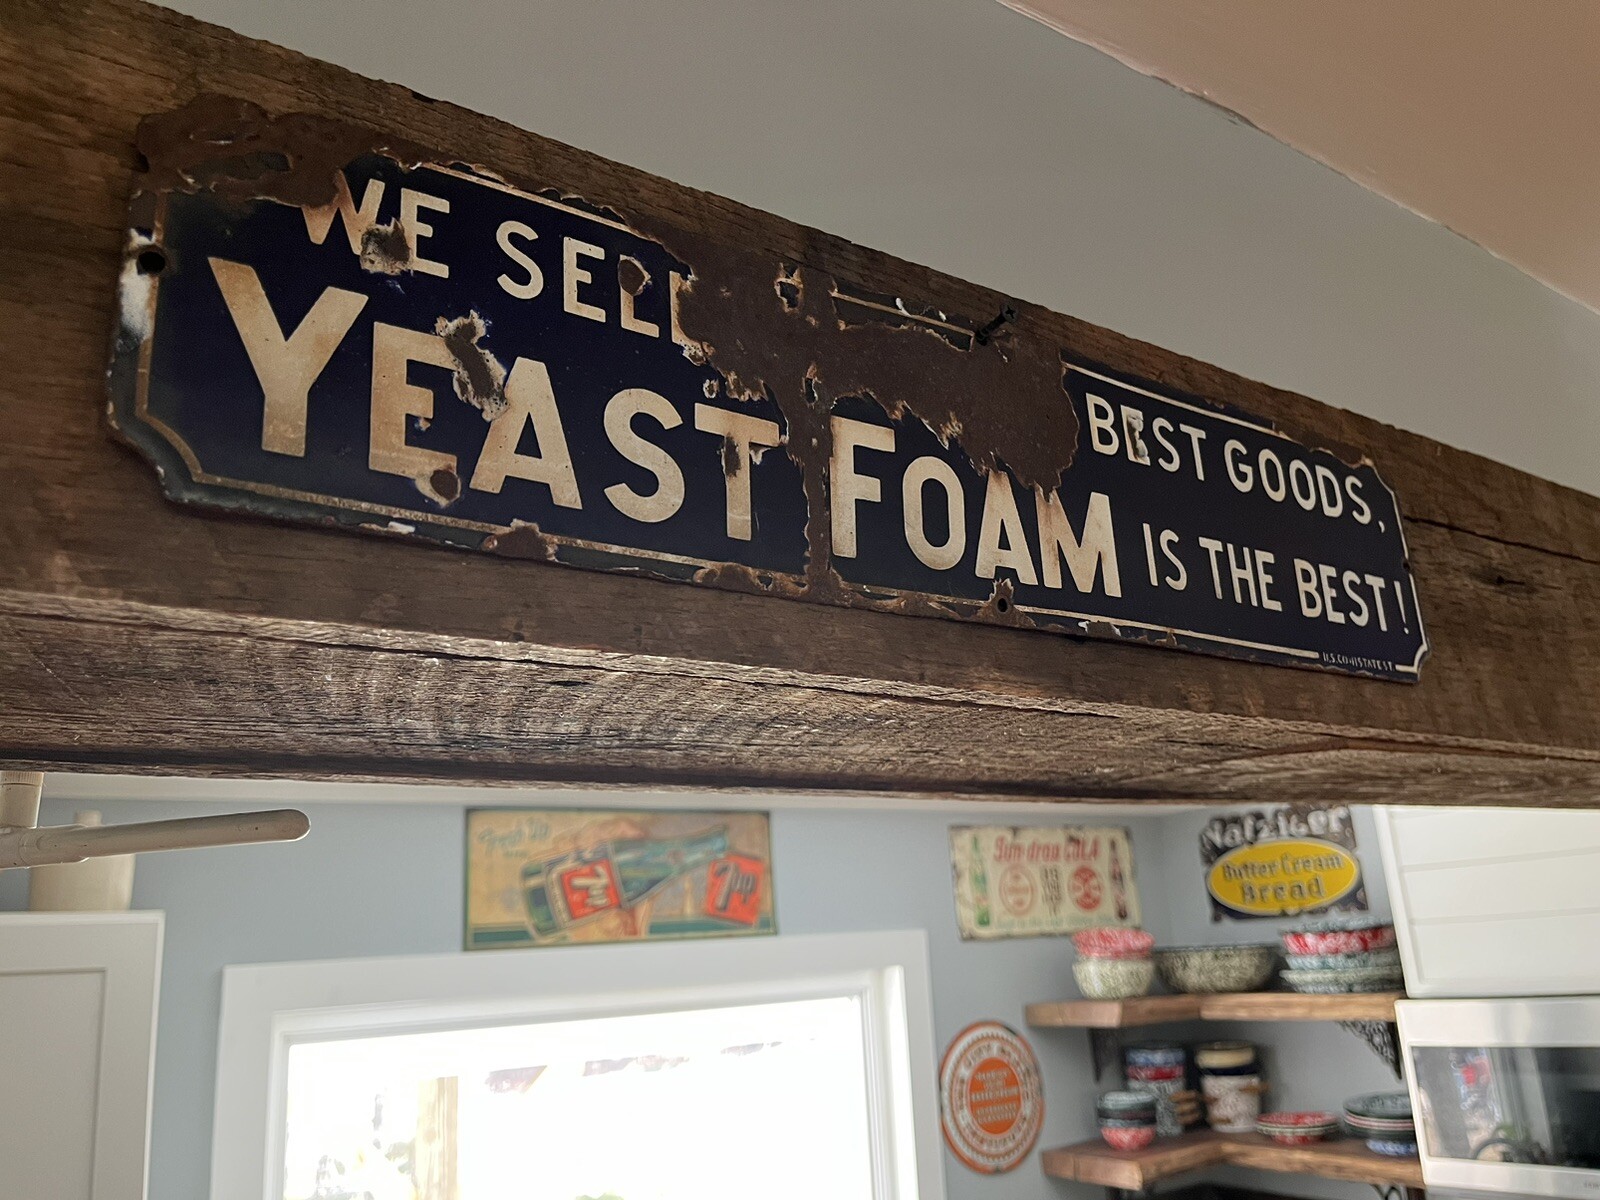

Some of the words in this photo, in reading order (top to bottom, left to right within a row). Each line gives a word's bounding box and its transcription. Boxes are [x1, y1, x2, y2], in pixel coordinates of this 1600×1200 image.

[300, 170, 451, 279] WE
[207, 255, 782, 541] YEAST
[829, 416, 1123, 598] FOAM
[1085, 392, 1206, 482] BEST
[1223, 438, 1386, 535] GOODS,
[1142, 522, 1188, 592] IS
[1198, 536, 1283, 613] THE
[1293, 557, 1410, 635] BEST!
[1241, 874, 1326, 905] Bread
